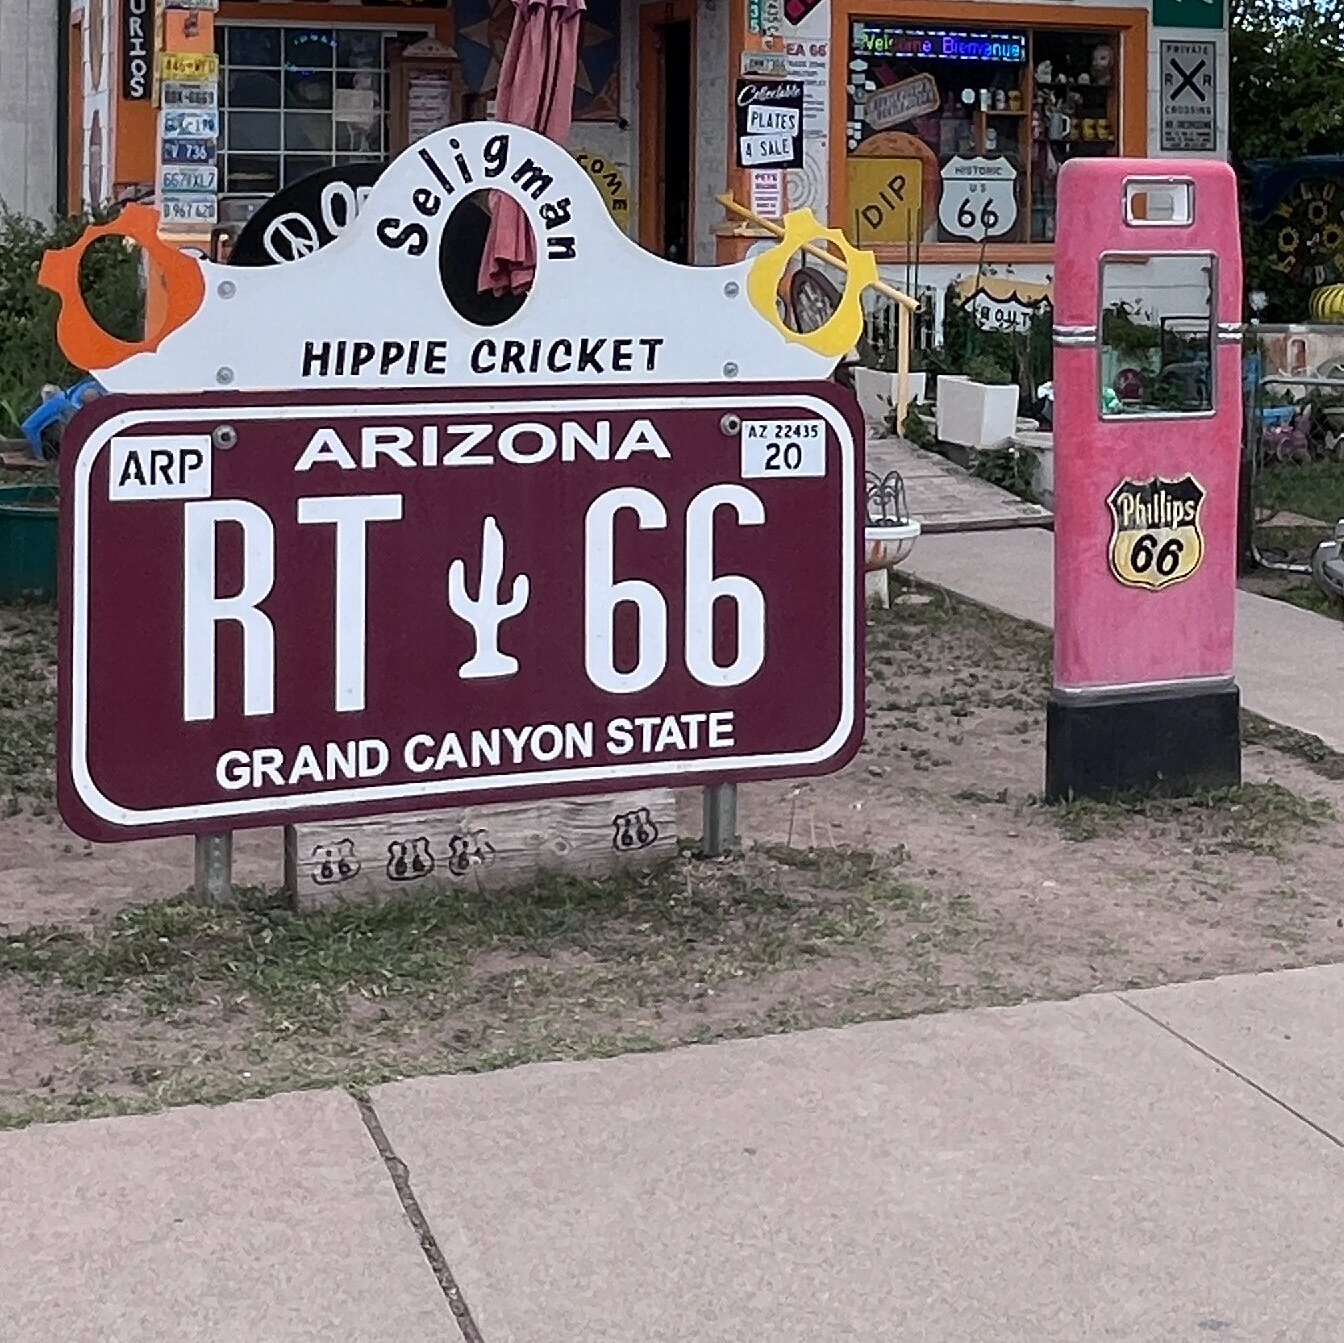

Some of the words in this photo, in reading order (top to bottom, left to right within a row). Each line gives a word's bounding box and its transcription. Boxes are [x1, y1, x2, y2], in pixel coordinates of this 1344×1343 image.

[1166, 44, 1209, 55] PRIVATE
[1164, 74, 1174, 85] R
[1203, 74, 1212, 86] R
[751, 110, 796, 130] PLATES
[746, 143, 752, 158] 4
[761, 138, 790, 157] SALE
[954, 165, 1004, 176] HISTORIC
[376, 132, 581, 261] Seligman
[861, 173, 908, 231] DIP
[957, 197, 999, 228] 66
[301, 339, 448, 377] HIPPIE
[470, 337, 665, 373] CRICKET
[294, 419, 672, 472] ARIZONA
[748, 424, 768, 438] AZ
[774, 424, 819, 439] 22435
[118, 449, 205, 488] ARP
[764, 442, 803, 471] 20
[1118, 488, 1197, 529] Phillips
[1129, 531, 1185, 577] 66
[183, 494, 404, 724] RT
[584, 484, 768, 694] 66
[215, 738, 390, 790] GRAND
[403, 722, 594, 774] CANYON
[604, 710, 736, 756] STATE
